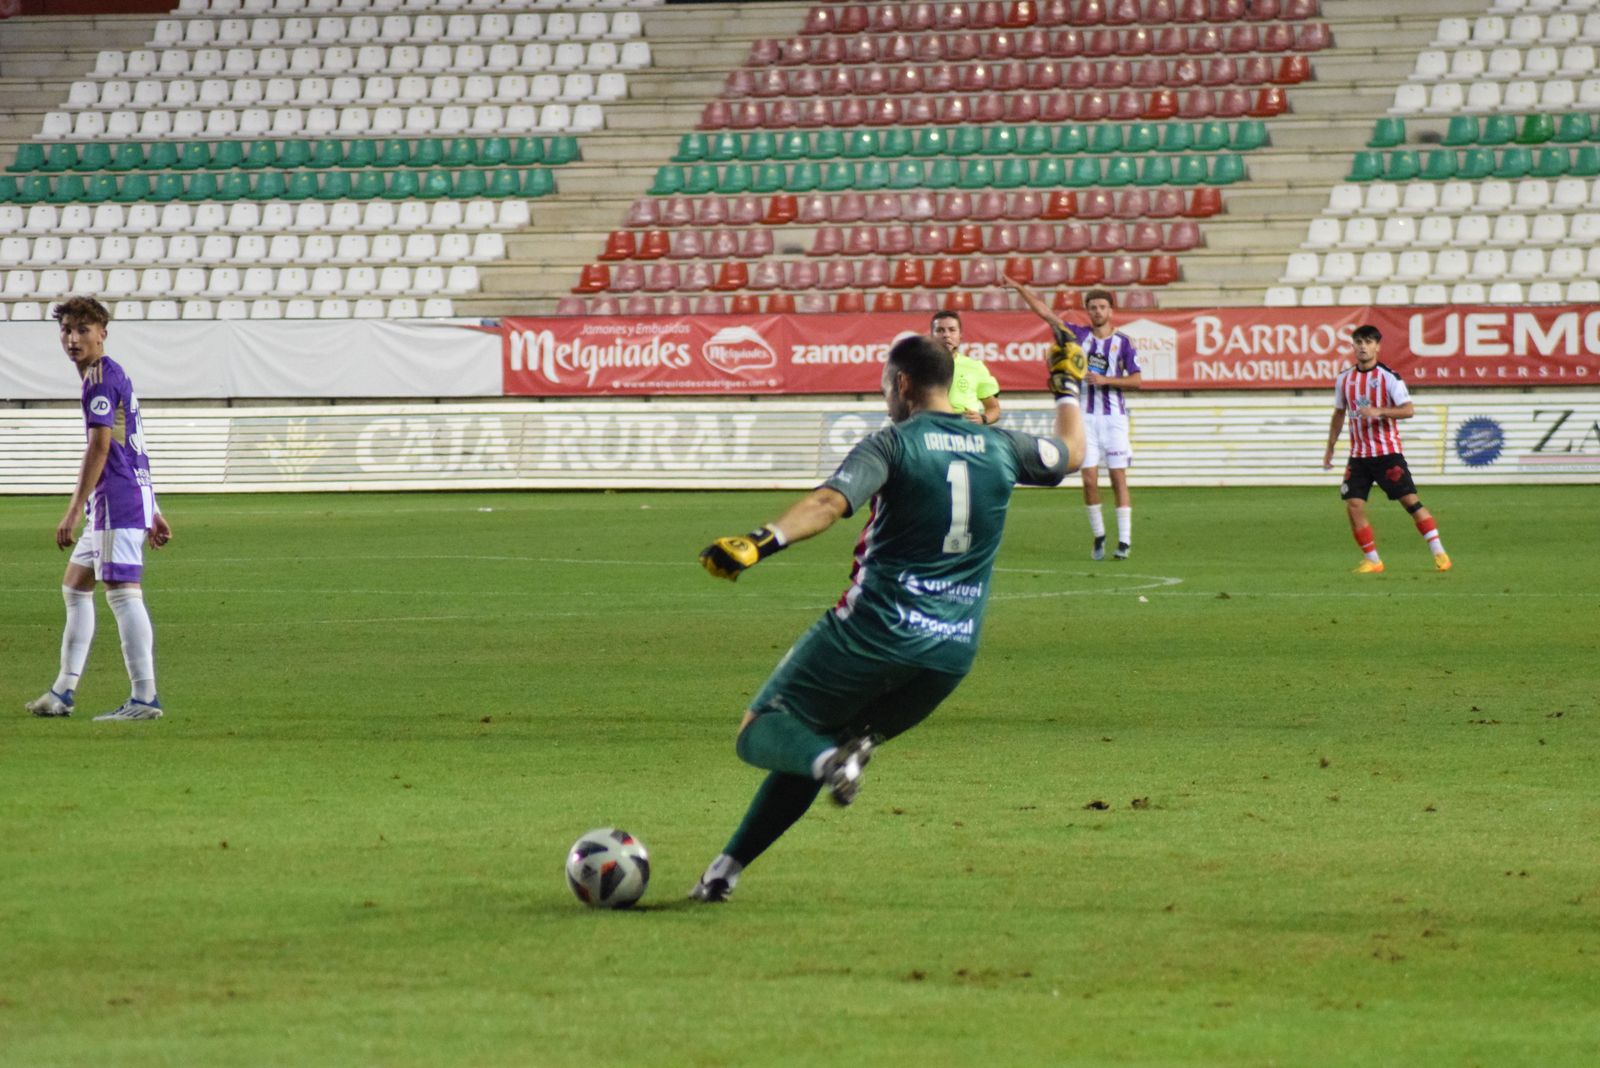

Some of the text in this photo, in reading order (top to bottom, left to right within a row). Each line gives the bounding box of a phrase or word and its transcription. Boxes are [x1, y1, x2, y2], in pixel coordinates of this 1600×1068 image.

[1193, 315, 1356, 355] BARRIOS
[1414, 366, 1600, 379] UNIVERSID
[93, 400, 108, 410] JD
[355, 413, 773, 478] CAJA RURAL
[942, 460, 972, 553] 1
